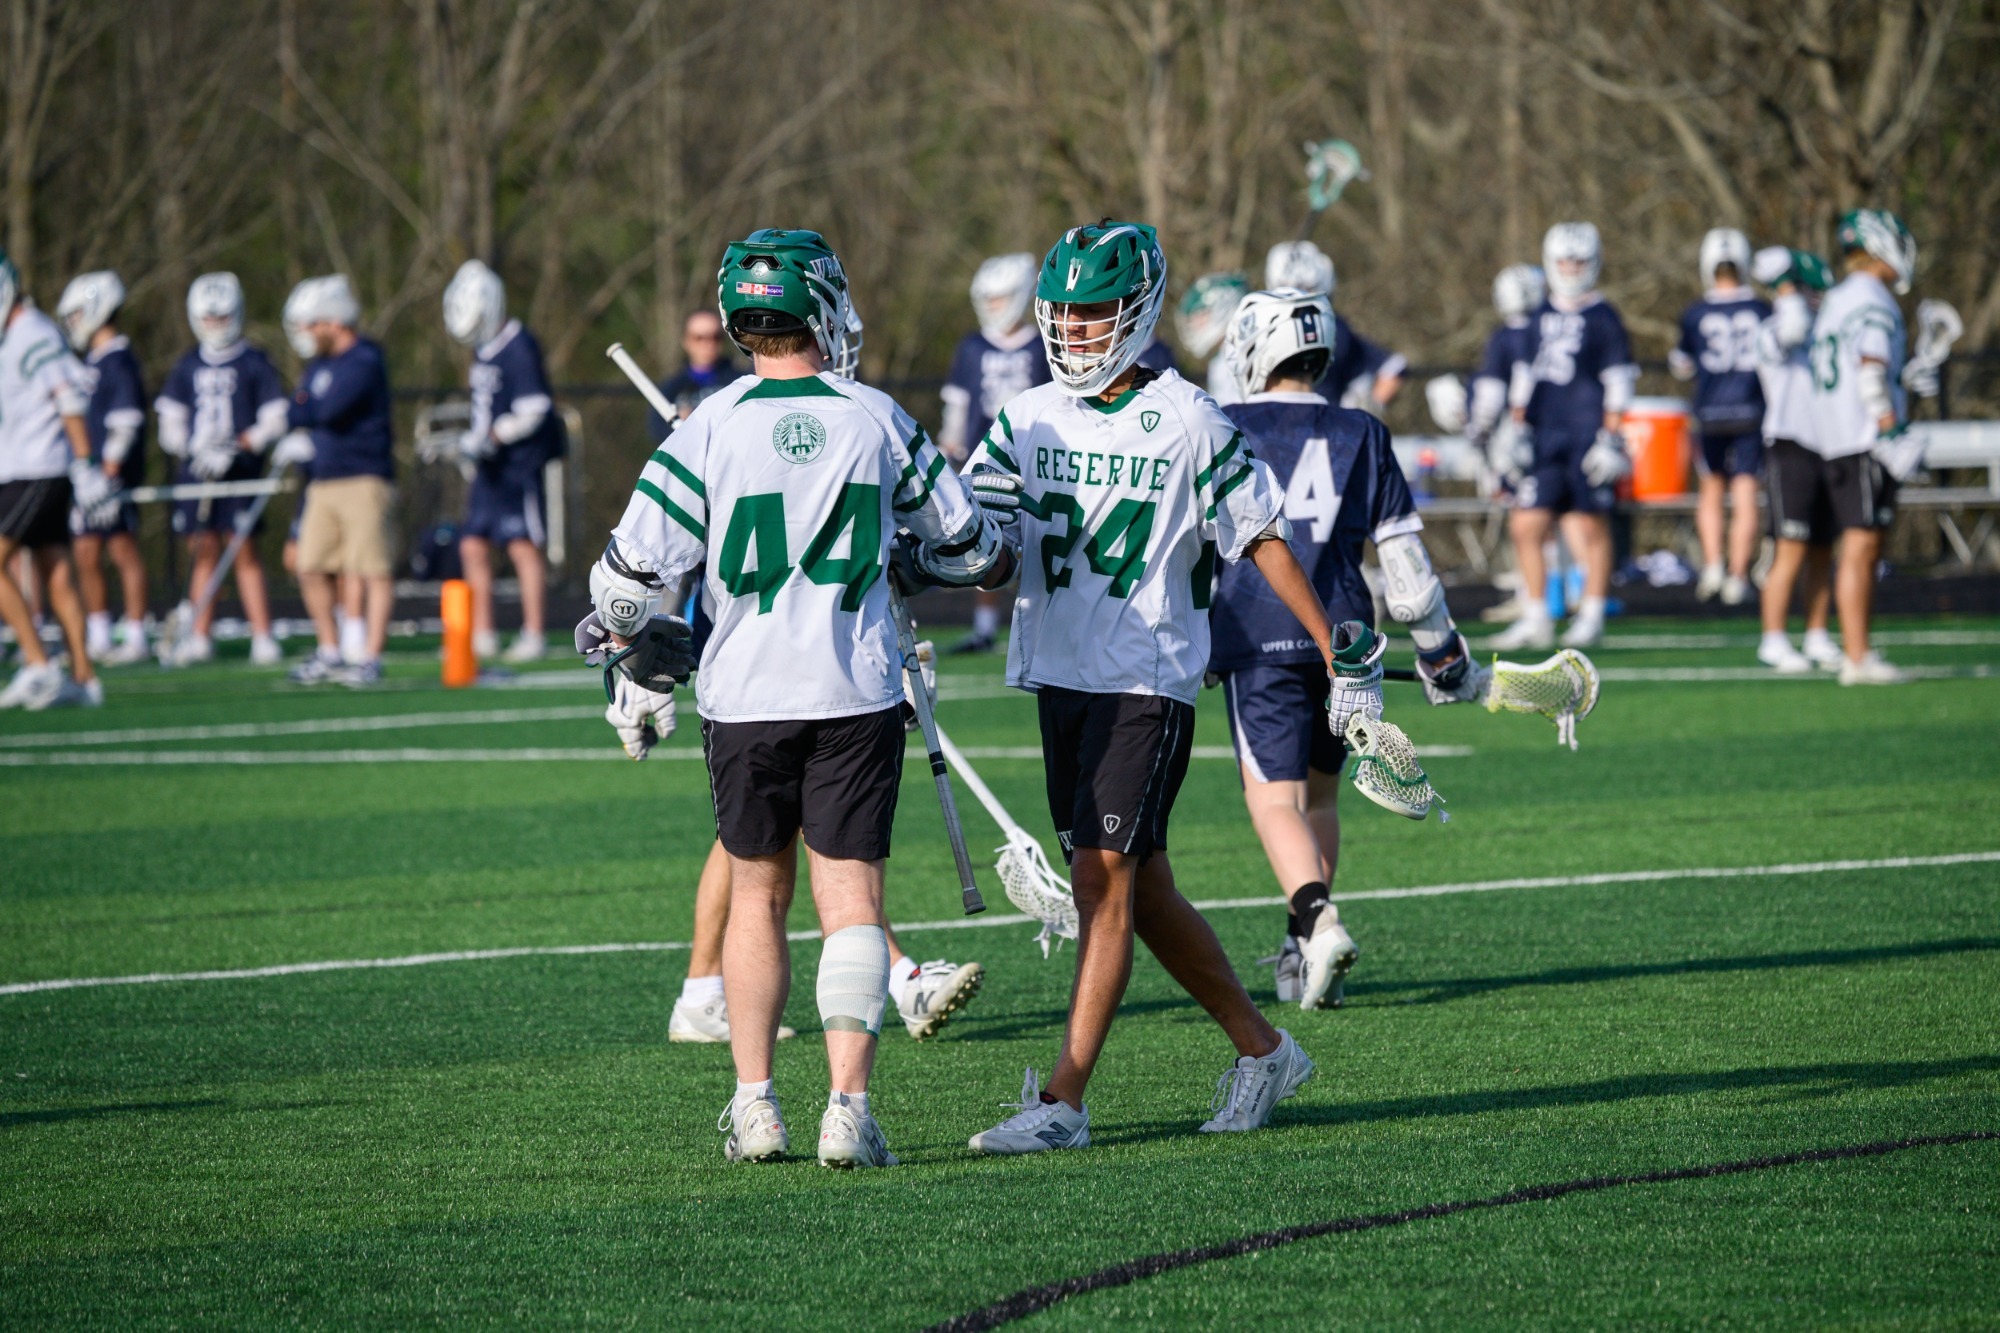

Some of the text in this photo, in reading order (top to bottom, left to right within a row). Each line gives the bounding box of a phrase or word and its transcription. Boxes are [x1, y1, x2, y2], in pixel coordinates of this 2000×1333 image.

[783, 414, 809, 424] RESERVE
[1036, 446, 1171, 491] RESERVE
[1284, 438, 1343, 543] 4
[718, 481, 883, 616] 44
[1039, 490, 1157, 600] 24
[1262, 640, 1295, 653] UPPER
